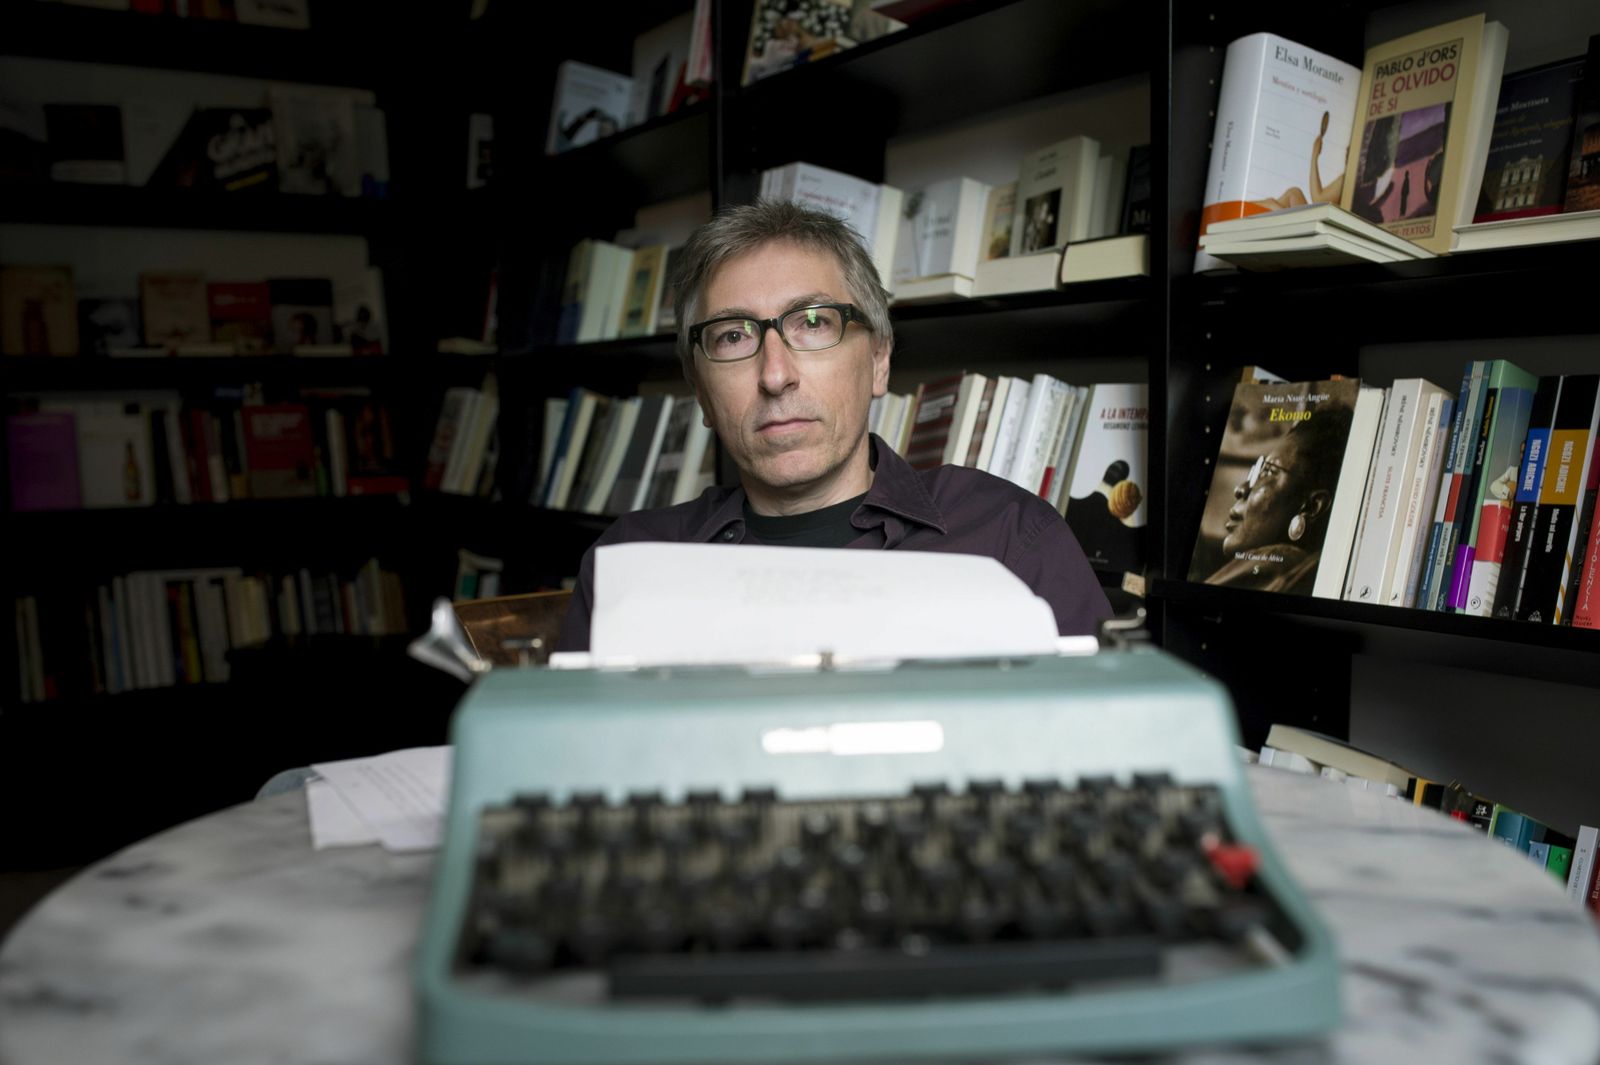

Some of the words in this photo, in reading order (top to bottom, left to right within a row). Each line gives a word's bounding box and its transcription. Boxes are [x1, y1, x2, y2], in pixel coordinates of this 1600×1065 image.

[1274, 45, 1299, 68] Elsa
[1303, 55, 1345, 86] Morante
[1375, 57, 1415, 80] PABLO
[1416, 44, 1457, 69] d'ORS
[1371, 81, 1387, 100] EL
[1391, 62, 1456, 95] OLVIDO
[1368, 100, 1385, 117] DE
[1107, 407, 1117, 420] LA
[1269, 407, 1312, 422] Ekomo
[1529, 439, 1541, 461] NGOZI
[1561, 441, 1574, 463] NGOZI
[1523, 462, 1537, 491] ADICHIE
[1555, 464, 1570, 494] ADICHIE
